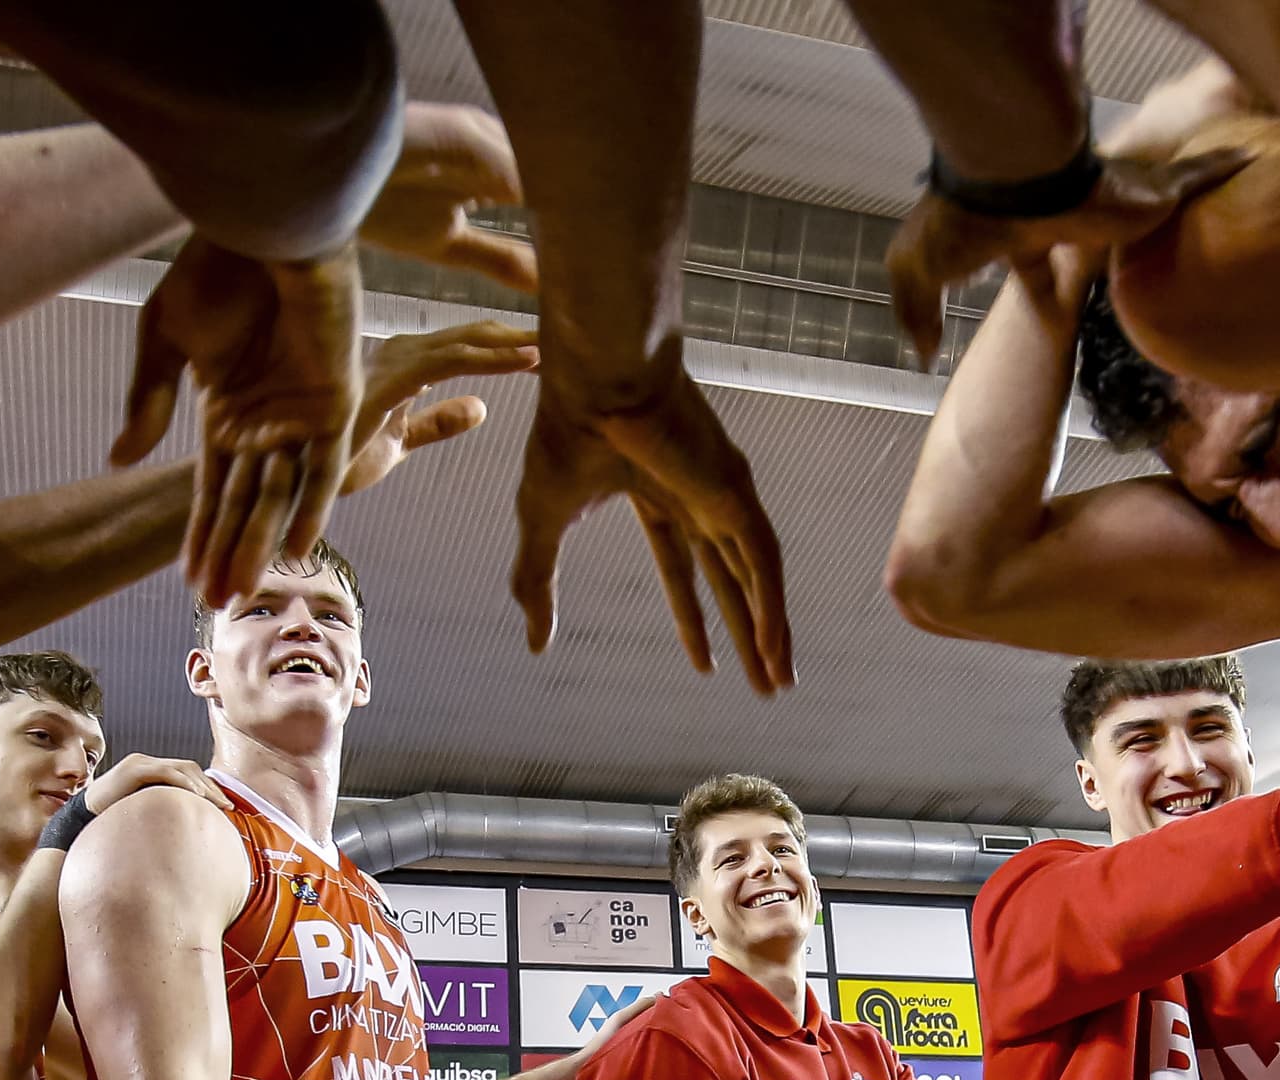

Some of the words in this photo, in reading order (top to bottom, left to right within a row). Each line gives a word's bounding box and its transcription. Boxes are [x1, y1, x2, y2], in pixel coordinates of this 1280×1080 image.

[610, 900, 634, 912] ca
[610, 914, 648, 927] non
[611, 927, 637, 943] ge
[294, 920, 424, 1021] BAX
[467, 1023, 501, 1033] DIGITAL
